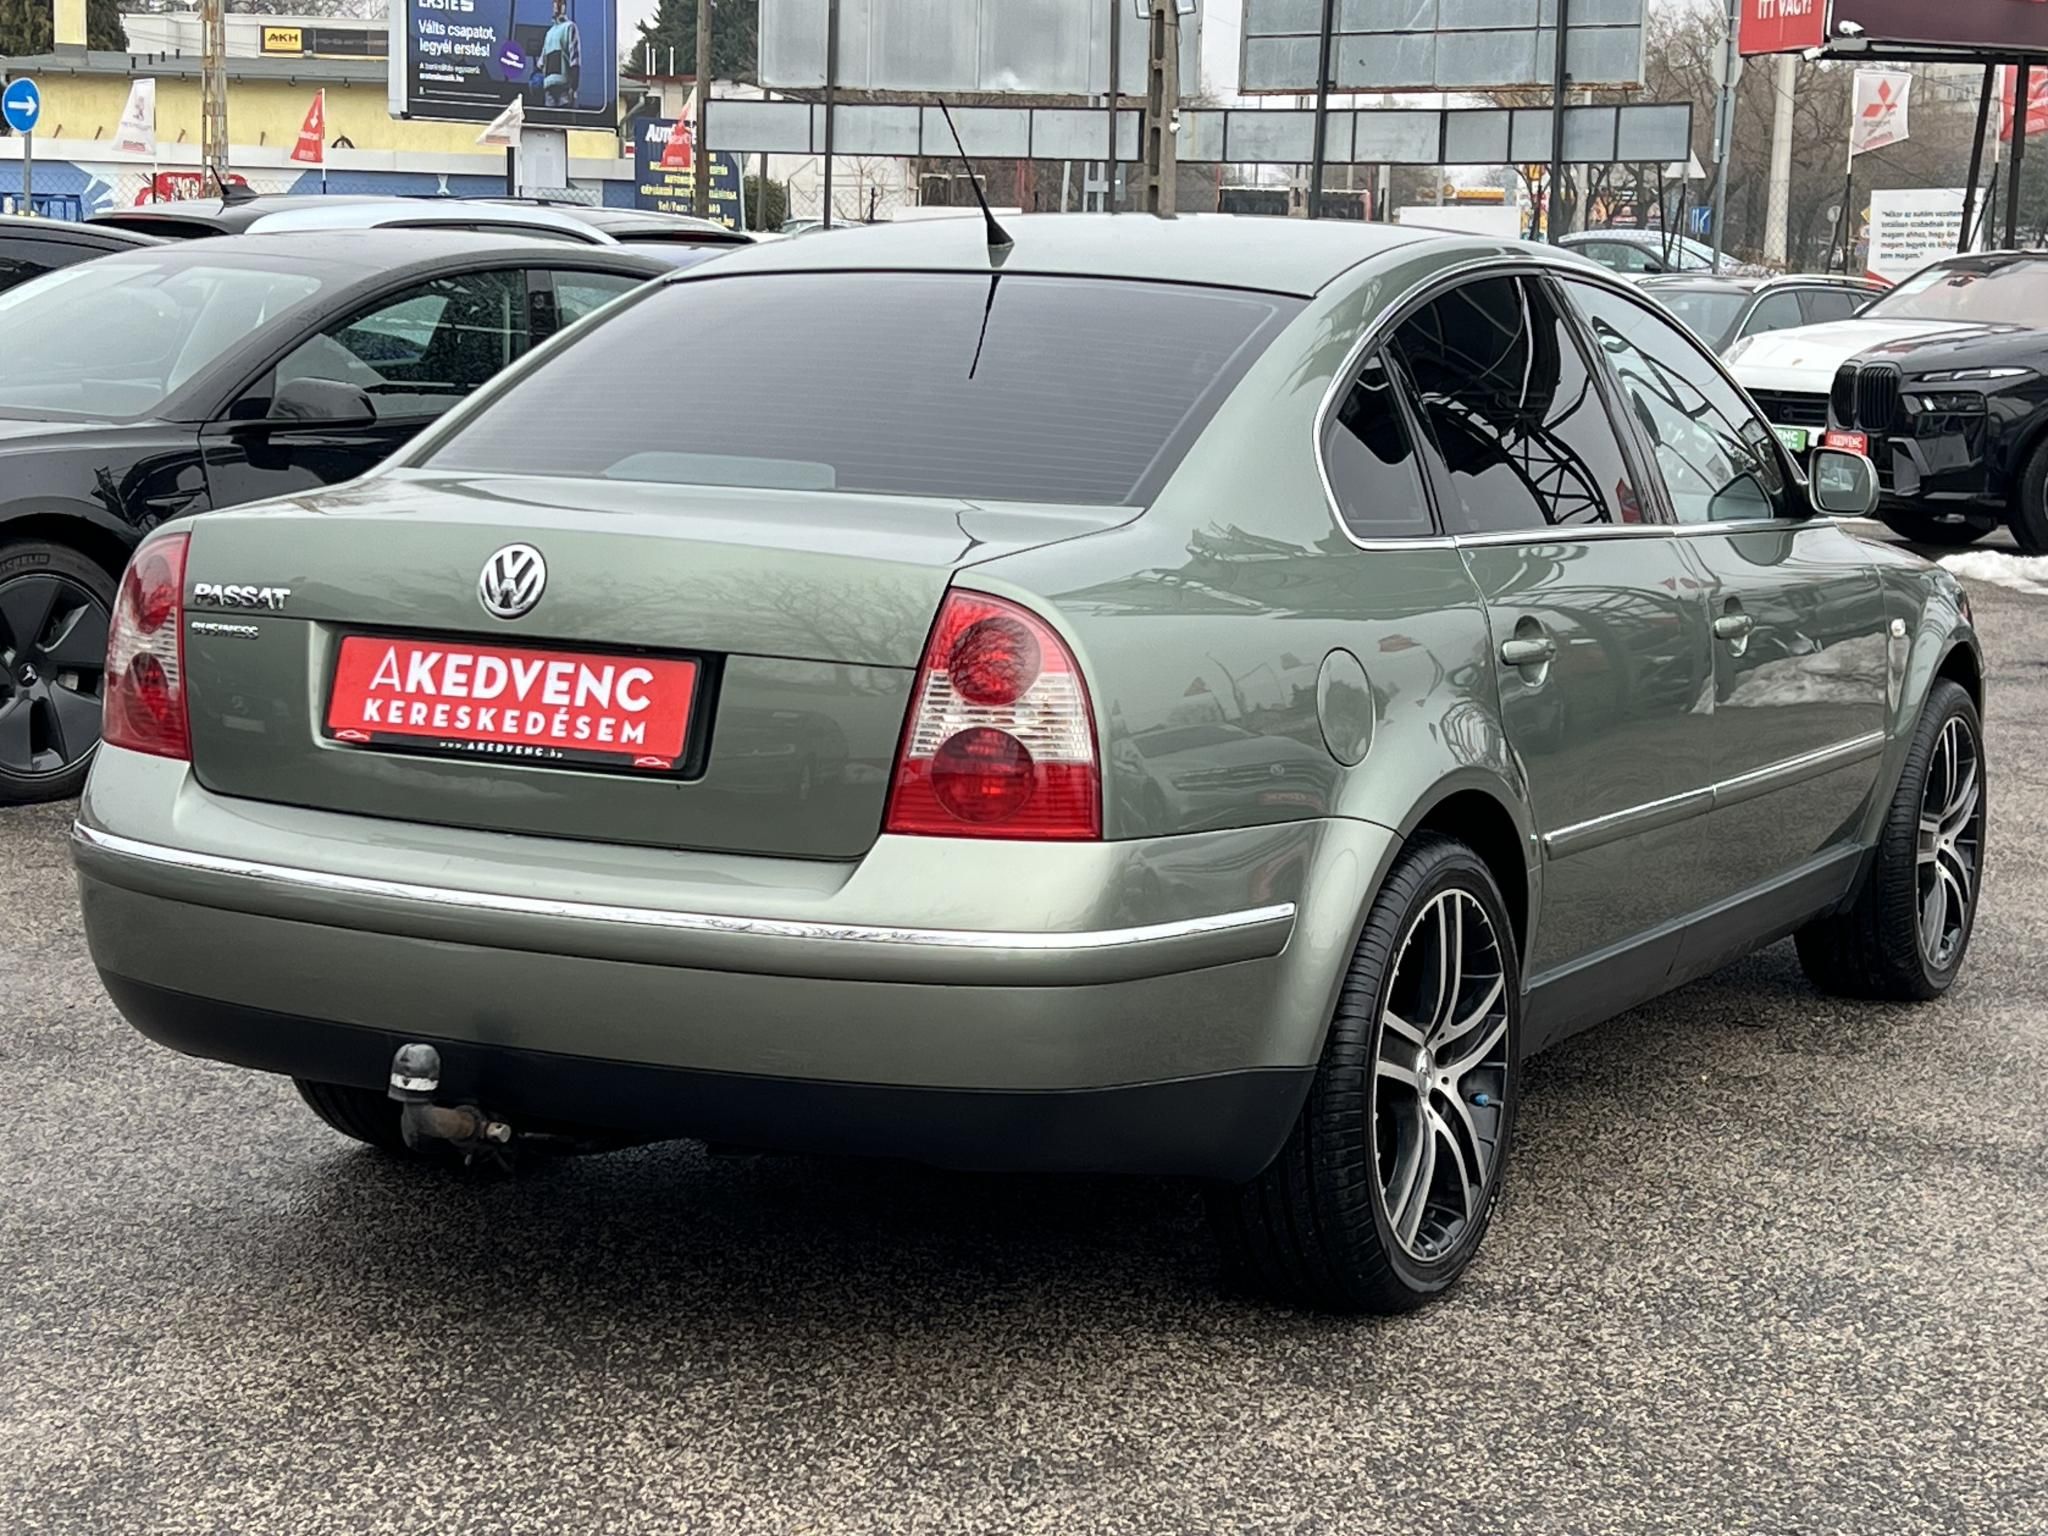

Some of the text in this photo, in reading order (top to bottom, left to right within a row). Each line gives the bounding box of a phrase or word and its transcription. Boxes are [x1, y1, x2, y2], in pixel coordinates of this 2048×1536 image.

[267, 33, 299, 43] AKH
[418, 18, 497, 43] Válts csapatot,
[419, 37, 491, 57] legyél erstés!
[193, 583, 291, 610] PASSAT
[190, 621, 260, 640] BUSINESS
[369, 646, 654, 712] AKEDVENC
[362, 697, 648, 746] KERESKEDÉSEM
